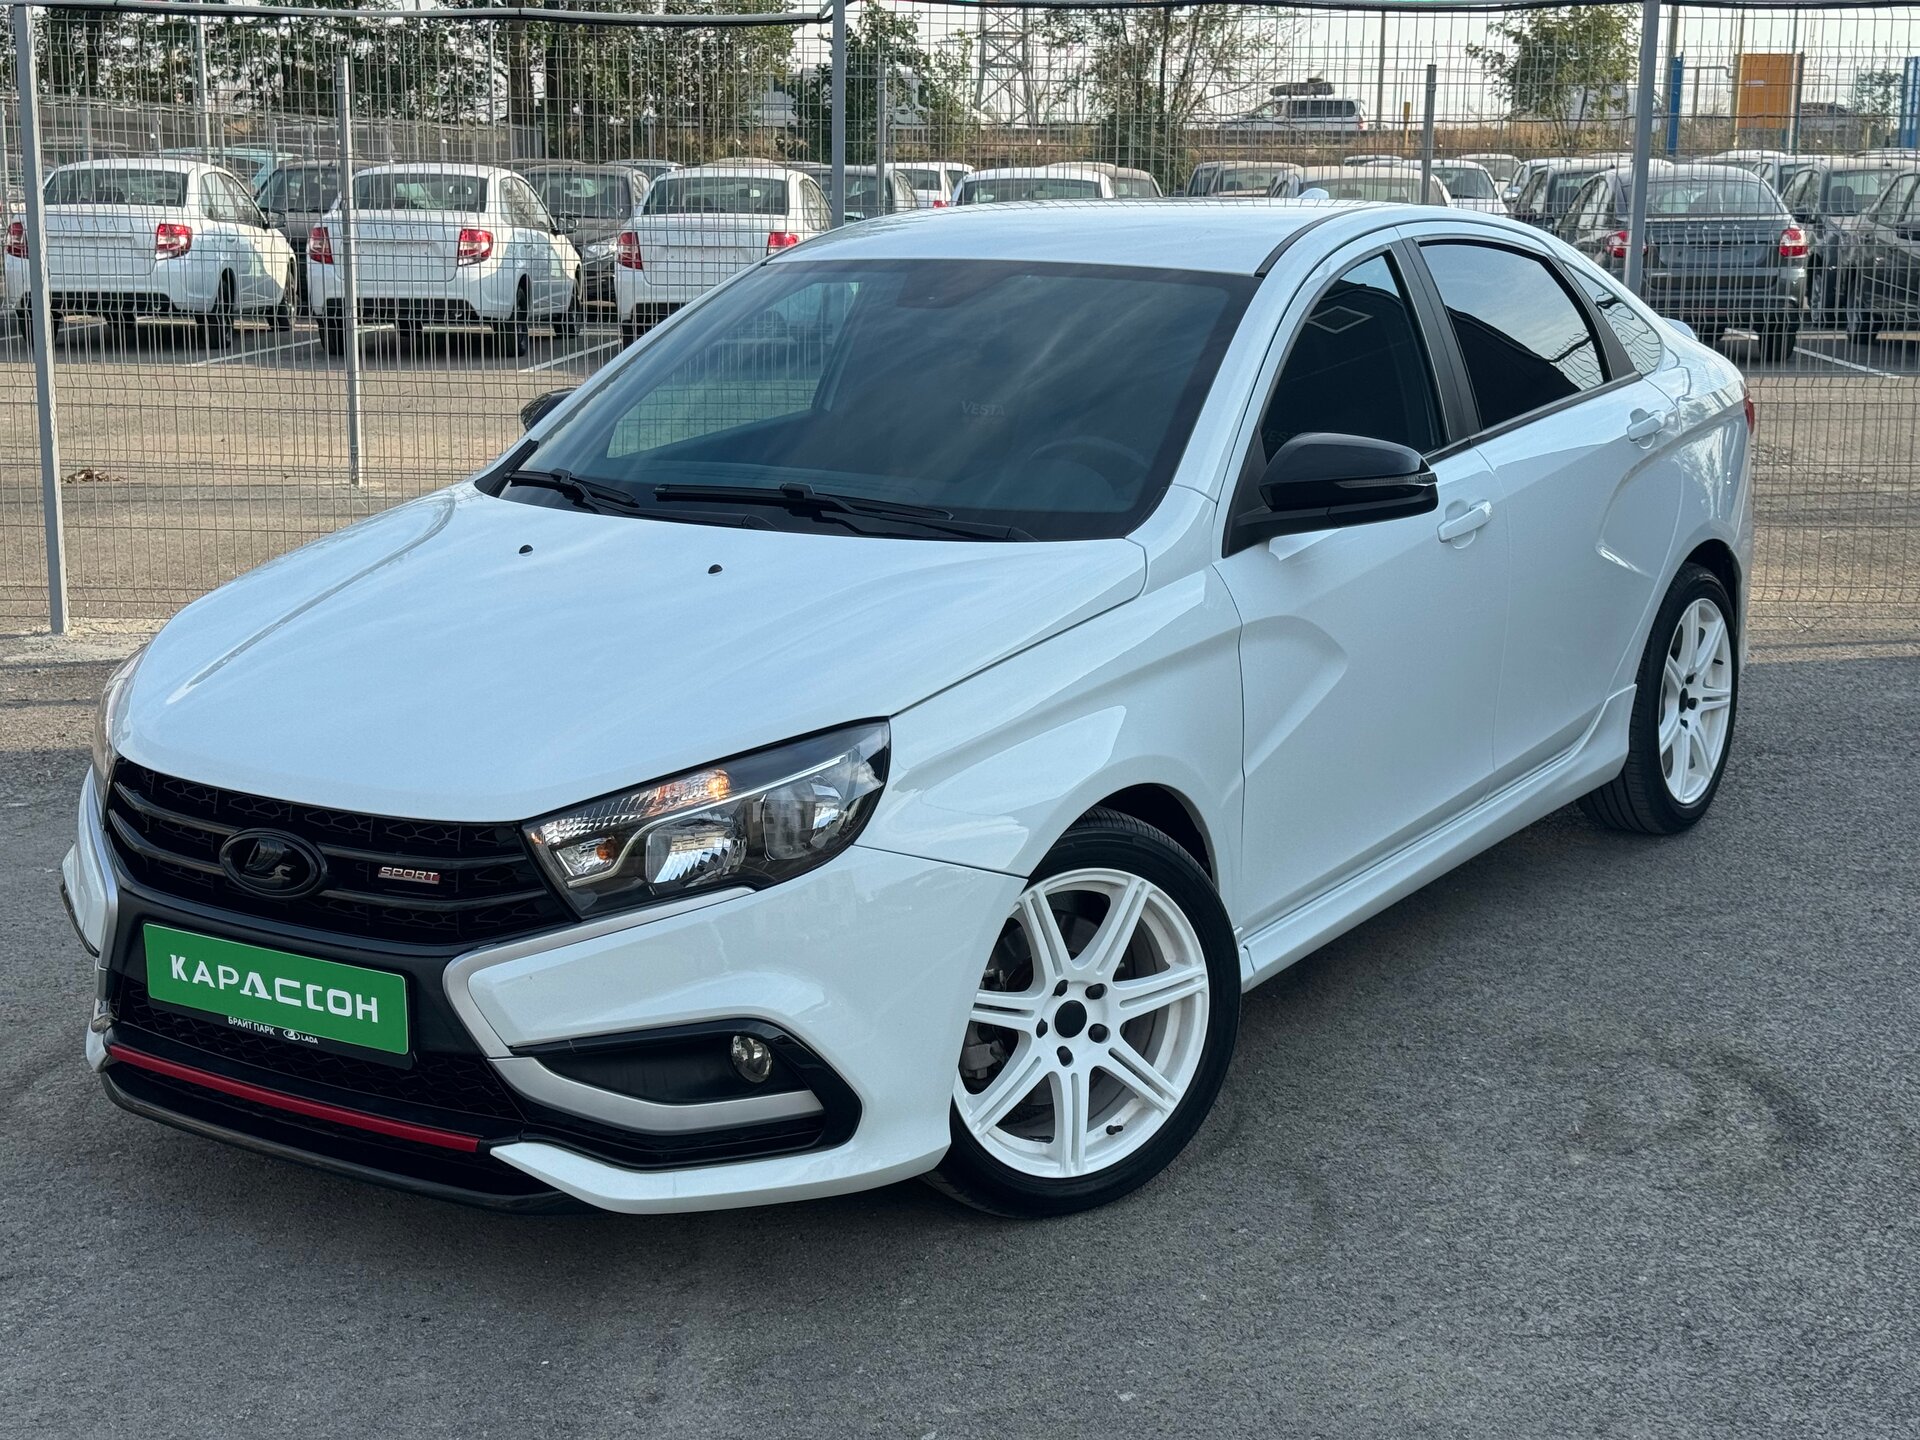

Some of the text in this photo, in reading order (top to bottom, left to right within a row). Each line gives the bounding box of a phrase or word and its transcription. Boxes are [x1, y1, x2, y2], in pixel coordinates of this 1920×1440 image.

[961, 400, 1005, 416] VESTA
[380, 866, 438, 883] SPORT
[253, 1022, 275, 1036] ПАРК
[301, 1034, 318, 1045] LADA
